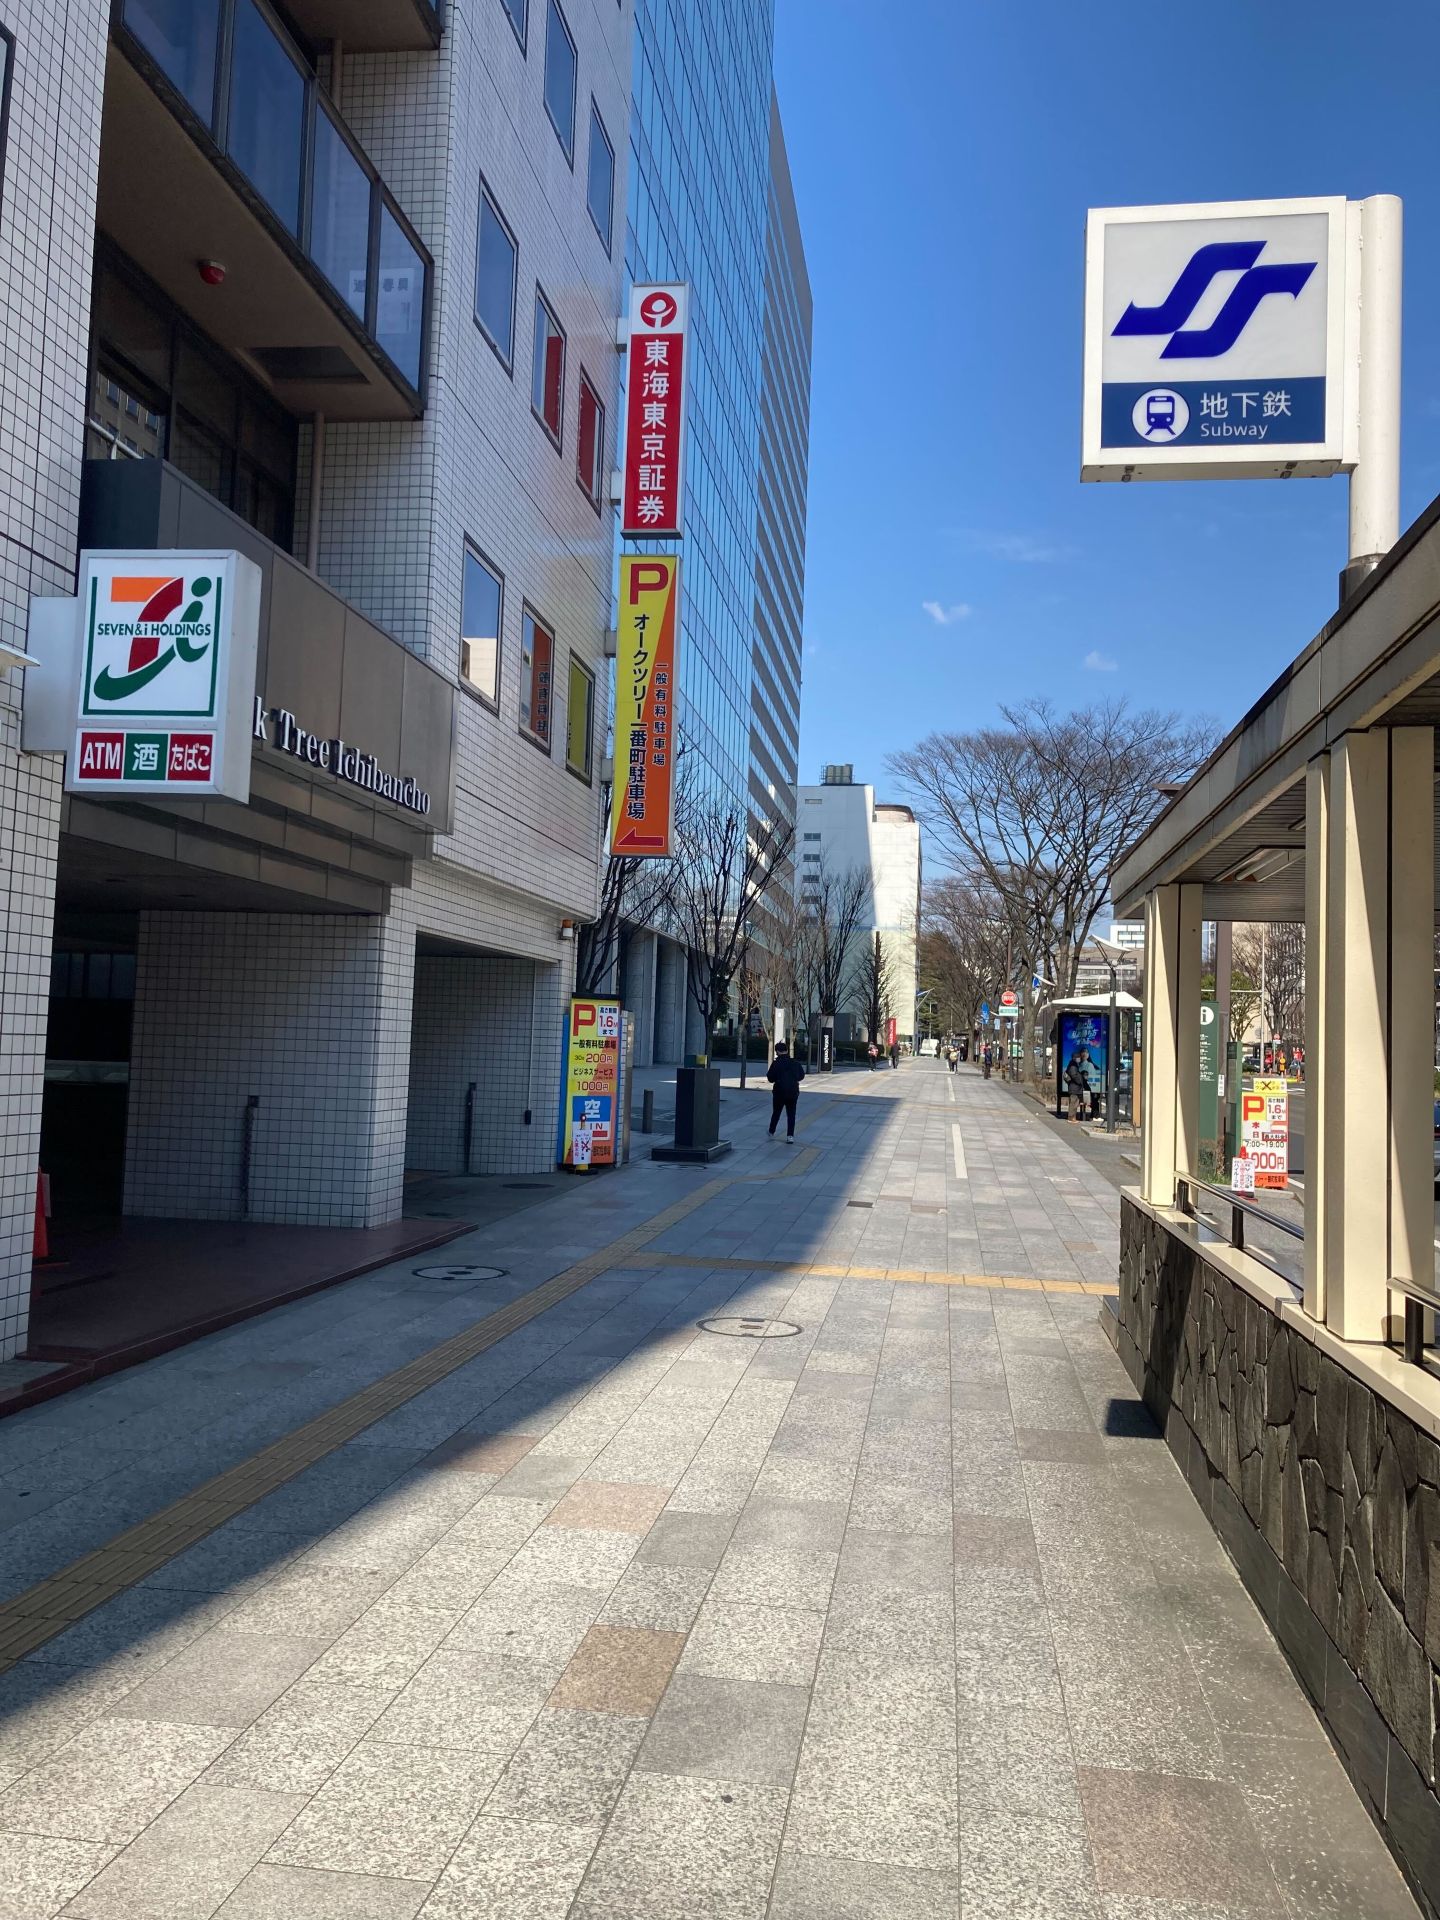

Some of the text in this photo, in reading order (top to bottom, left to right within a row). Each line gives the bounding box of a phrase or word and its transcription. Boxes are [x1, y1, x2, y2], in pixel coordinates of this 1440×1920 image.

[353, 278, 408, 292] 避器具
[1200, 390, 1292, 417] 地下鉄
[637, 339, 669, 523] 東海東京証券
[1200, 422, 1268, 439] Subway
[629, 563, 669, 605] P
[97, 623, 211, 636] SEVEN&i HOLDINGS
[627, 614, 650, 820] オークツリー一番町駐車場
[652, 663, 668, 766] 一般有料駐車場
[82, 742, 121, 770] ATM
[132, 743, 160, 771] 酒
[170, 742, 210, 771] たばこ
[279, 708, 330, 768] Tree
[336, 739, 431, 815] Ichibancho
[573, 1004, 596, 1036] P
[574, 1068, 613, 1076] ビジネスサービス
[586, 1053, 613, 1064] 200円
[577, 1081, 609, 1092] 1000円
[585, 1099, 600, 1119] 空
[1243, 1096, 1264, 1121] P
